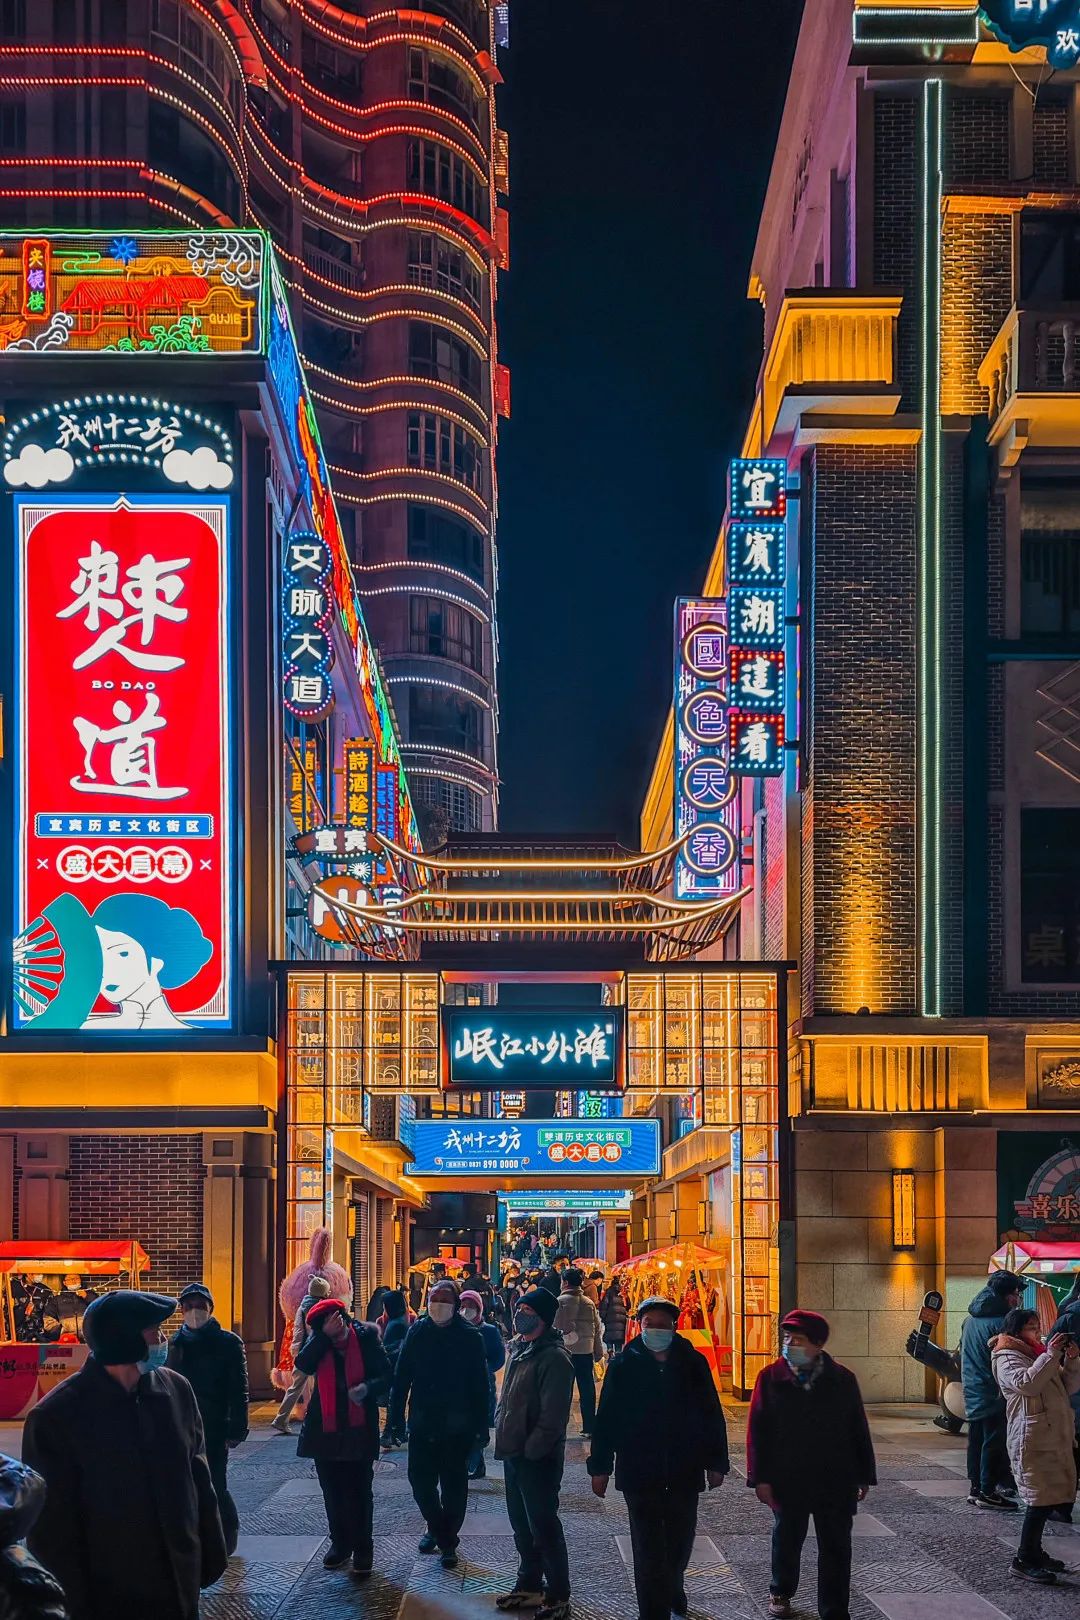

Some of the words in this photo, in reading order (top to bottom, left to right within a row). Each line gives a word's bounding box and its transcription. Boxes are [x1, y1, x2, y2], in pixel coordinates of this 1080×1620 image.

[209, 313, 242, 325] GUJIE
[290, 544, 323, 704] 文脉大道
[91, 680, 114, 690] BO
[121, 680, 156, 691] DAO
[65, 854, 186, 876] 盛大启幕
[455, 1024, 610, 1069] 岷江小外滩
[551, 1145, 619, 1159] 盛大启幕
[483, 1159, 497, 1169] 890
[500, 1159, 518, 1169] 0000
[486, 1214, 495, 1224] 27
